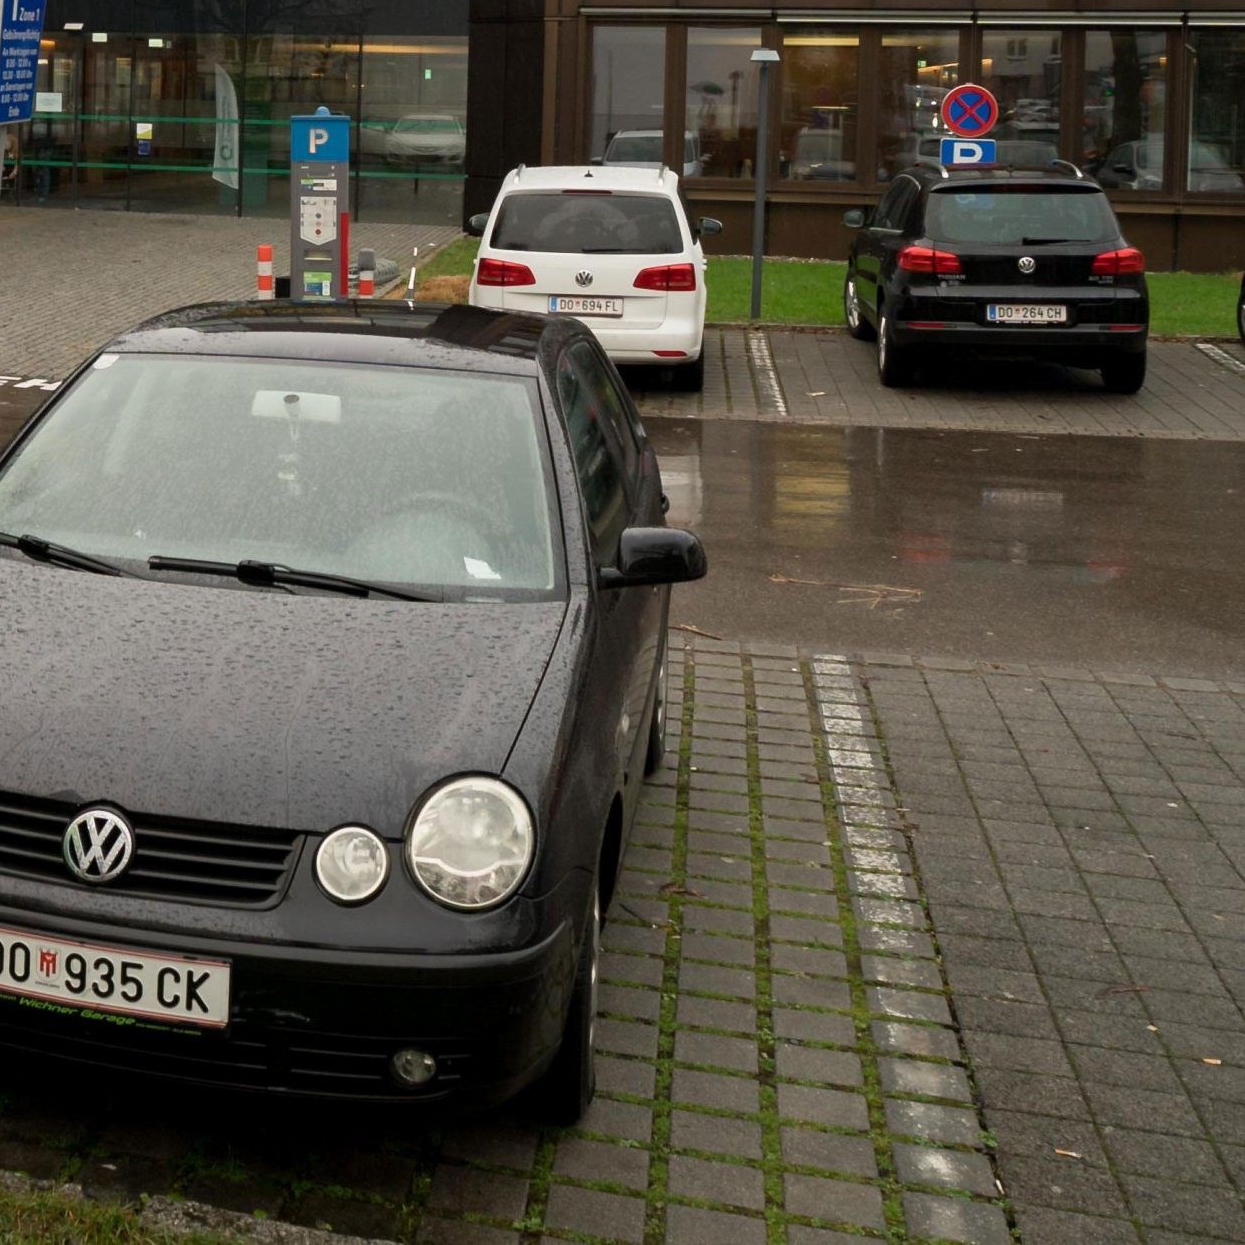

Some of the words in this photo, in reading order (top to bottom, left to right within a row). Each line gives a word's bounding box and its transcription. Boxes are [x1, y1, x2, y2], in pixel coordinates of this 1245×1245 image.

[19, 7, 35, 21] Zone
[35, 8, 41, 21] 1
[309, 129, 329, 154] P
[582, 300, 603, 311] 694
[605, 300, 619, 312] FL
[998, 306, 1014, 318] DO
[1022, 306, 1044, 318] 264
[1046, 307, 1062, 318] CH
[64, 809, 133, 882] VW
[64, 952, 144, 1003] 935
[156, 966, 210, 1014] CK
[19, 996, 79, 1015] Wichner
[80, 1008, 136, 1026] Garage
